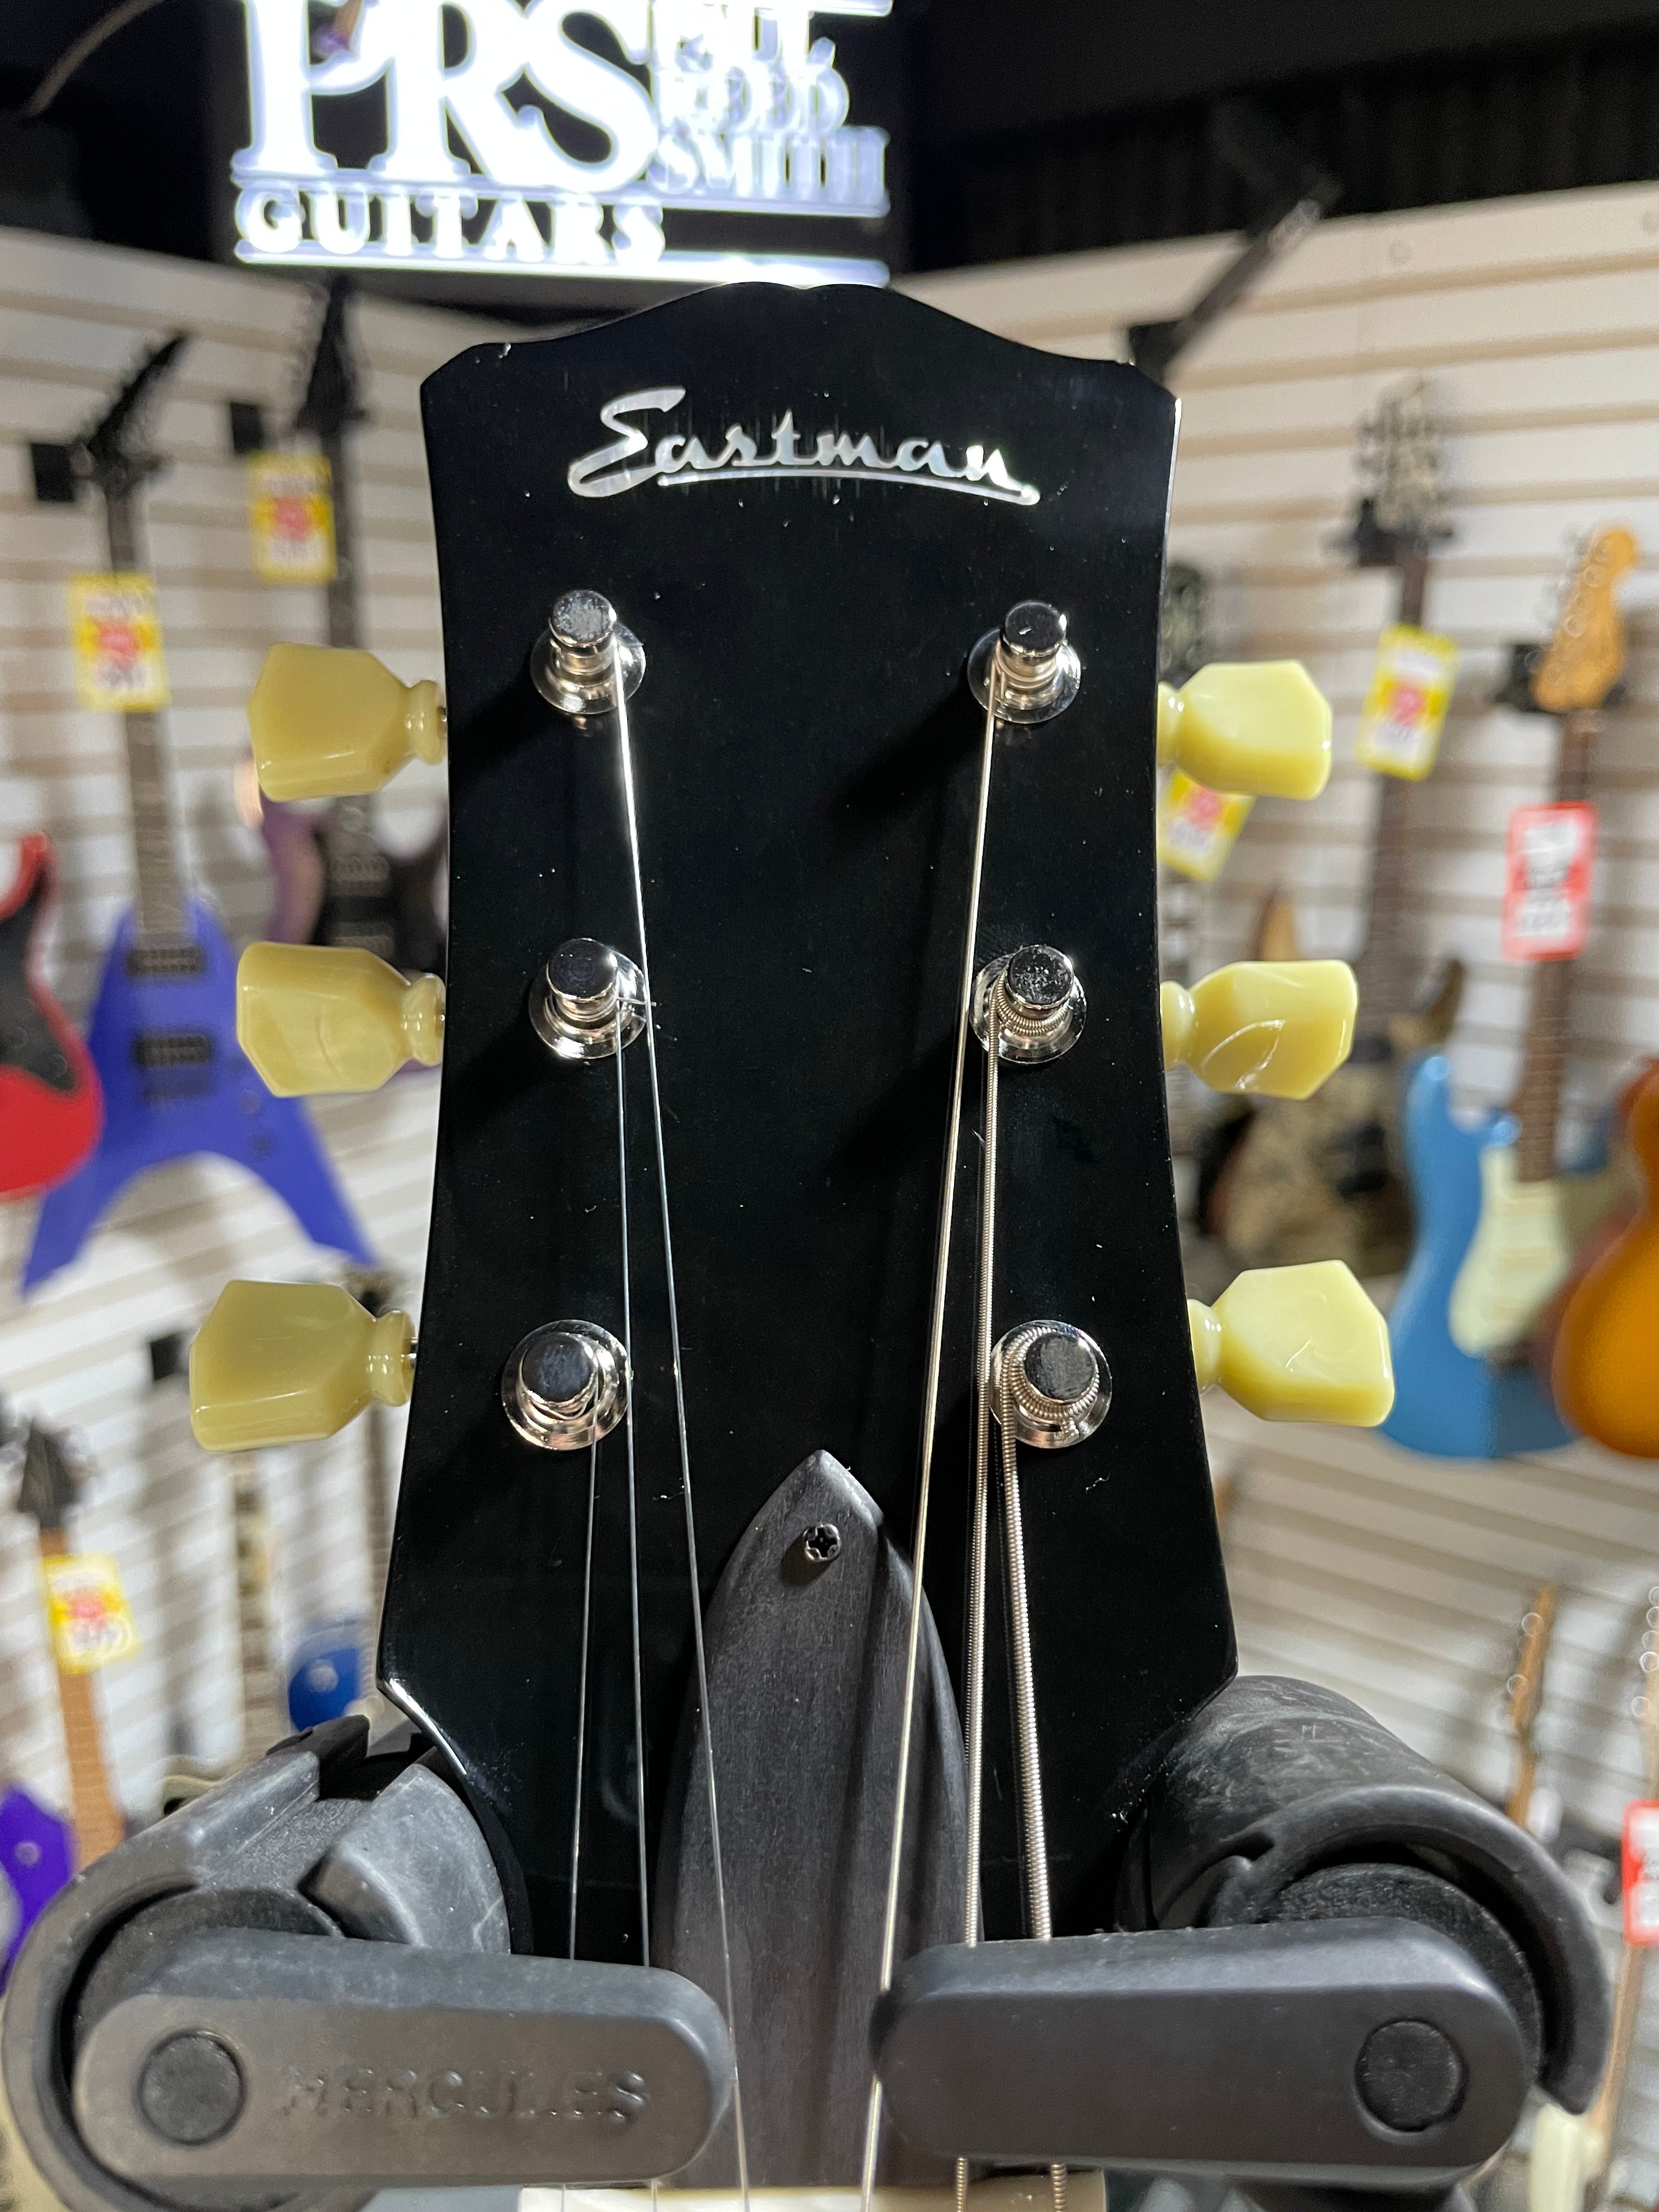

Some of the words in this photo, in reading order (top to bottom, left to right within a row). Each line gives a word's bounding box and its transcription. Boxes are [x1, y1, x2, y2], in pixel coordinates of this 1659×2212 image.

[231, 0, 658, 191] PRS
[235, 181, 665, 266] GUITARS
[567, 385, 1040, 505] Eastman
